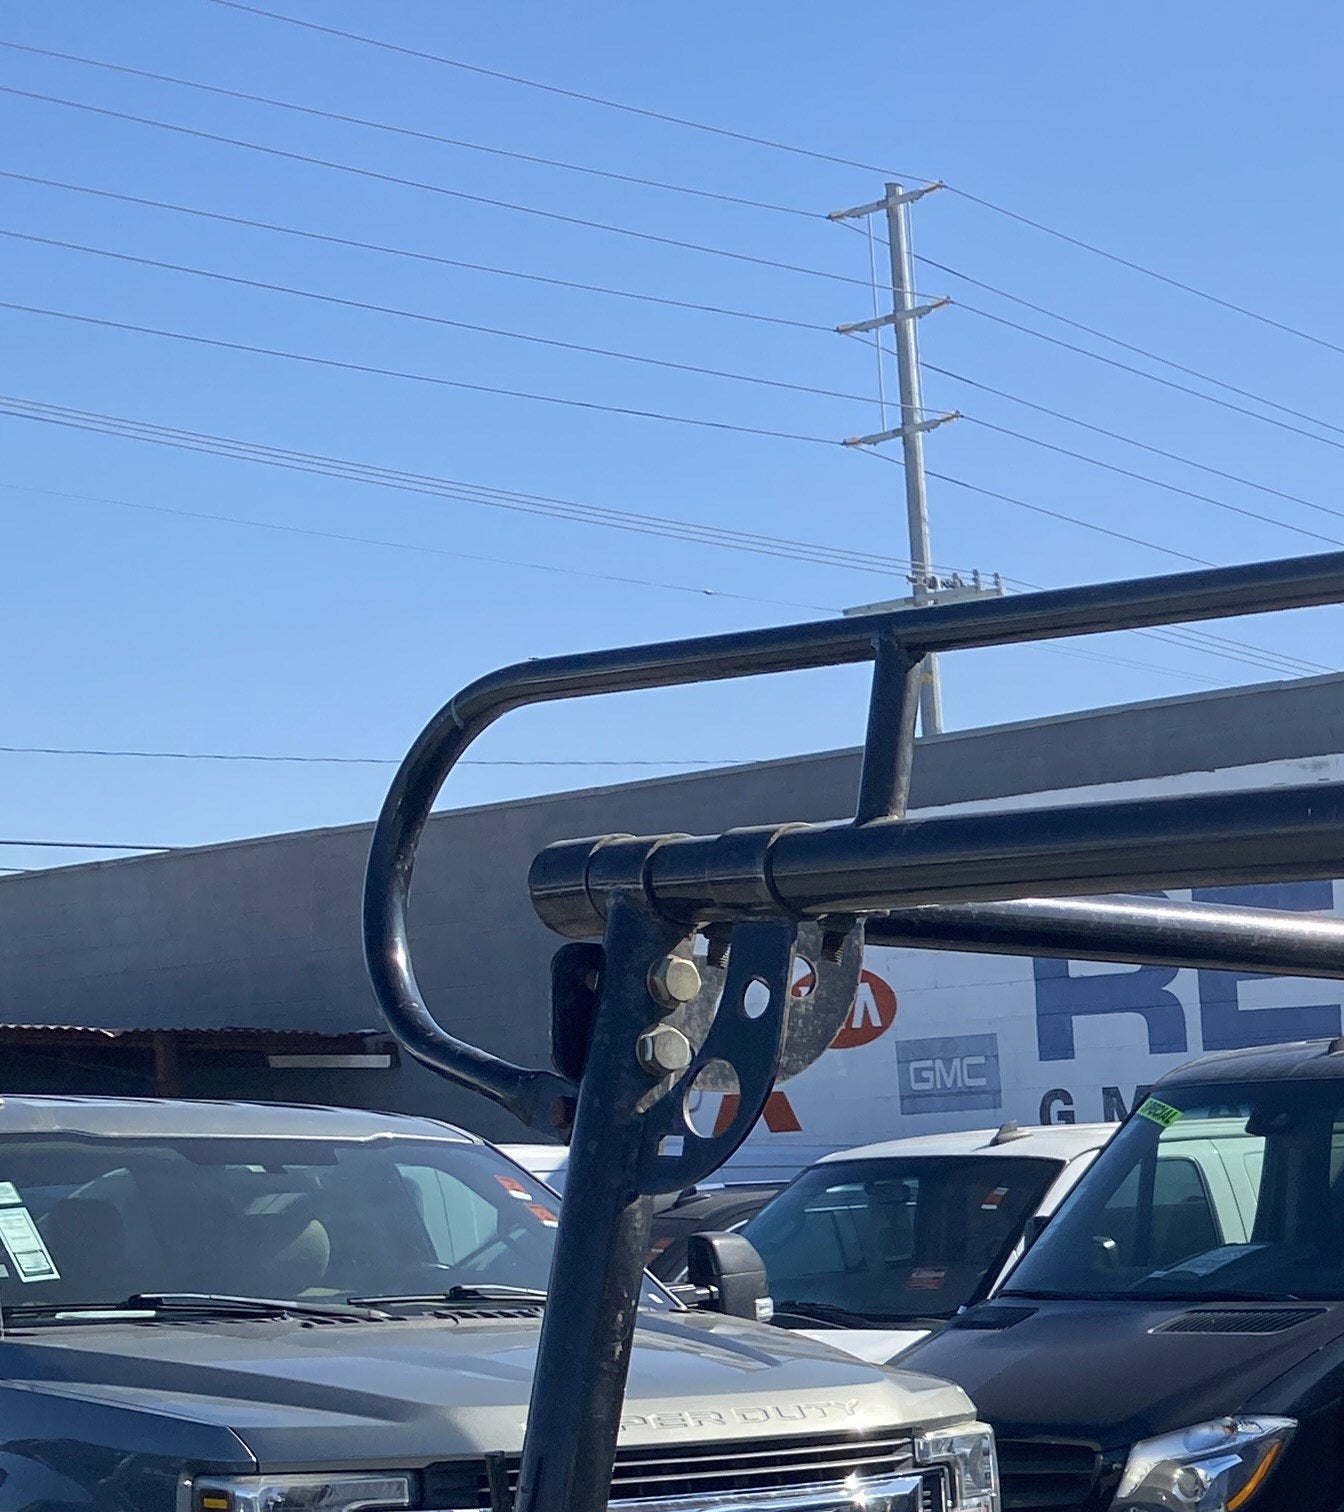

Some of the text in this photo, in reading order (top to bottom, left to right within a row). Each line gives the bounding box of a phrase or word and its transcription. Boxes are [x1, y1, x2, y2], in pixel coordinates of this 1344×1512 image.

[909, 1055, 987, 1091] GMC
[620, 1397, 860, 1432] PER DUTY
